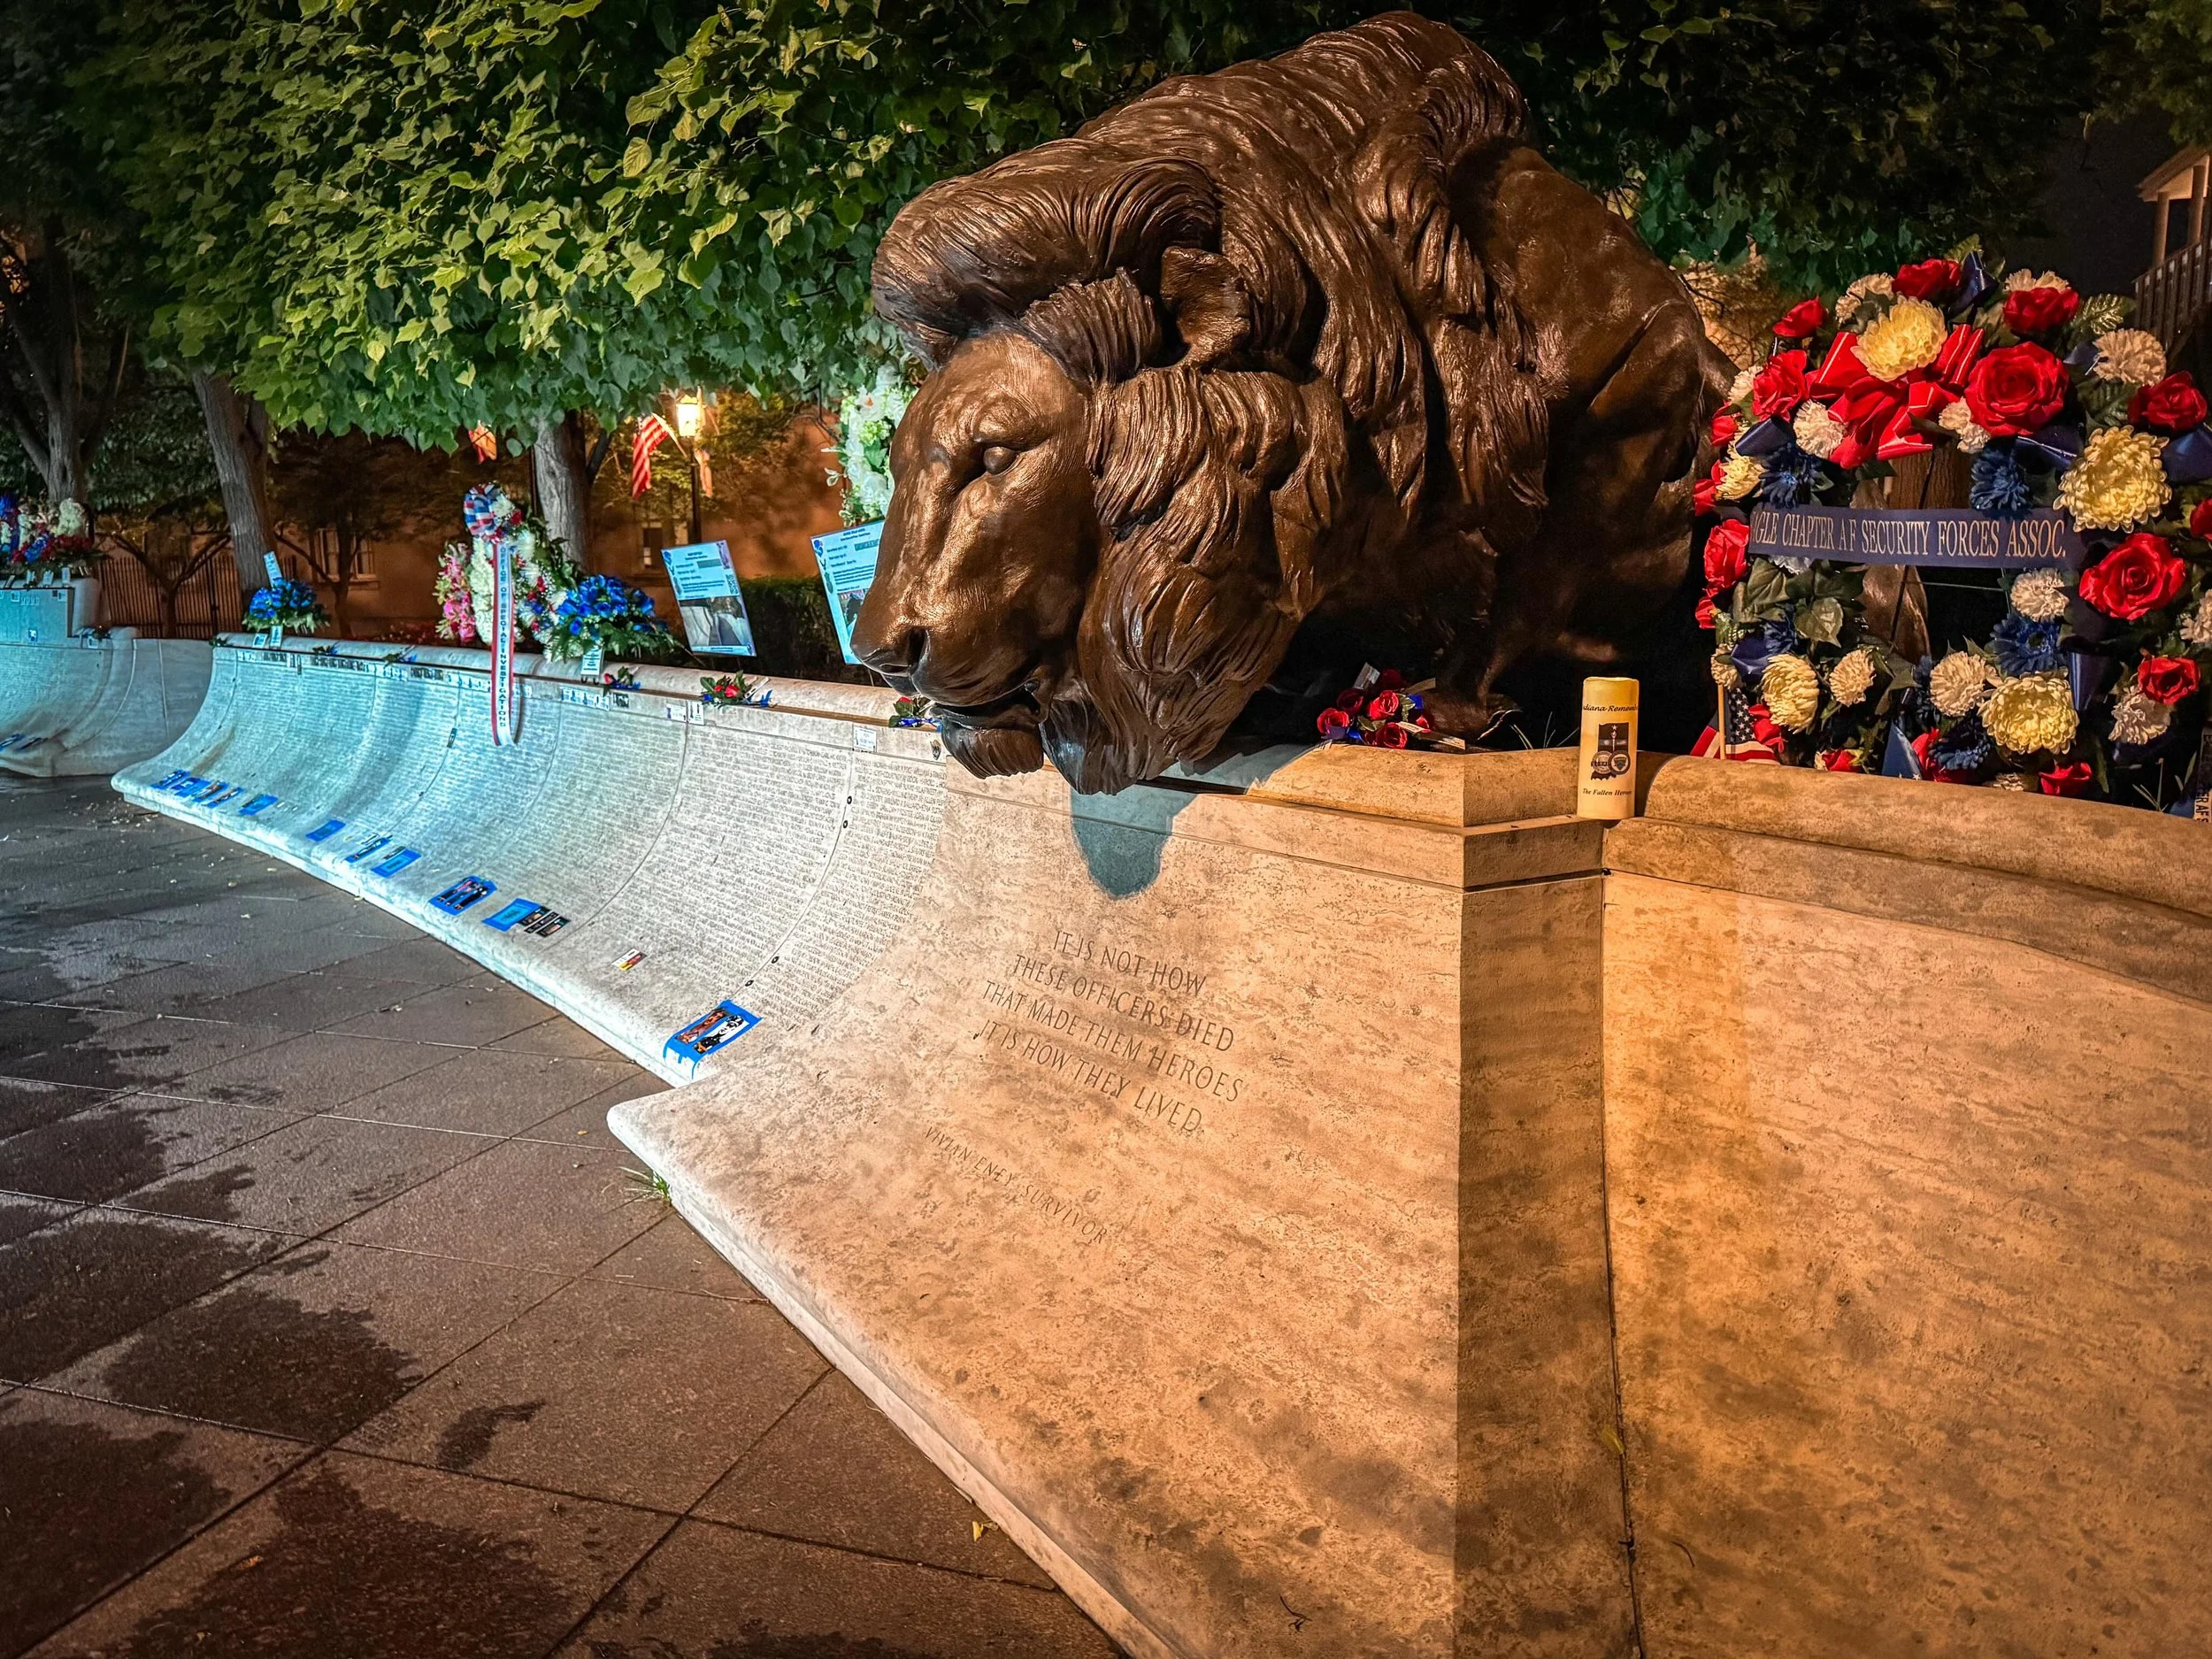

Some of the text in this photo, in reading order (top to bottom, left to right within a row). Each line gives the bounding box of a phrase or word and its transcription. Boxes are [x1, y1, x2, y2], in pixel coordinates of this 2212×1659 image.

[1782, 513, 1835, 550] CHAPTER
[1861, 519, 1931, 556] SECURITY
[1936, 519, 2000, 557] FORCES
[2005, 518, 2066, 558] ASSOC.
[1013, 954, 1234, 1052] THESE OFFICERS DIED
[1053, 931, 1207, 998] IT IS NOT HOW
[979, 1019, 1202, 1133] IT IS HOW THEY LIVED
[982, 979, 1243, 1102] THAT MADE THEM HEROES
[925, 1126, 1107, 1244] VIVIAN ENEY SURVIVOR
